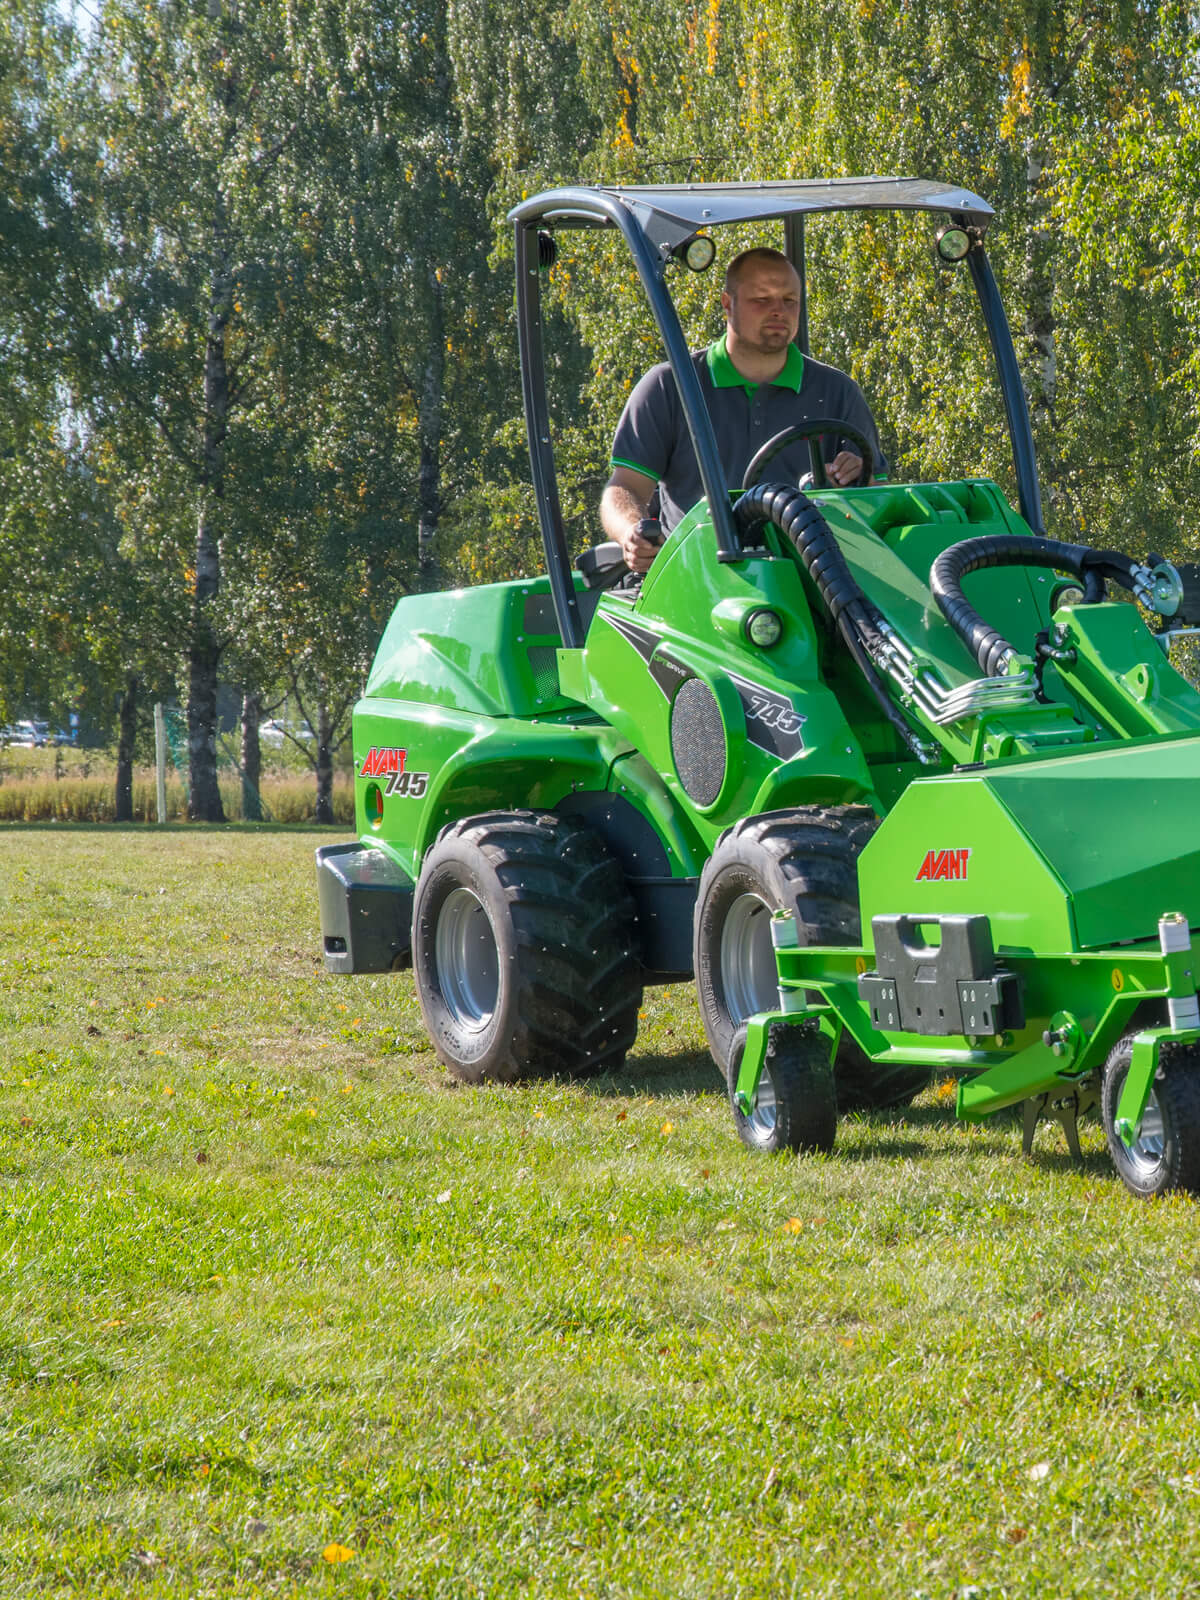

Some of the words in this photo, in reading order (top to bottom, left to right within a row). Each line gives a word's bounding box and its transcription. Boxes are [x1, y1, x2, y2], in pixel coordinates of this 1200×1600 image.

[745, 695, 808, 734] 745
[359, 746, 407, 778] AVANT
[384, 770, 430, 799] 745
[915, 848, 972, 882] AVANT
